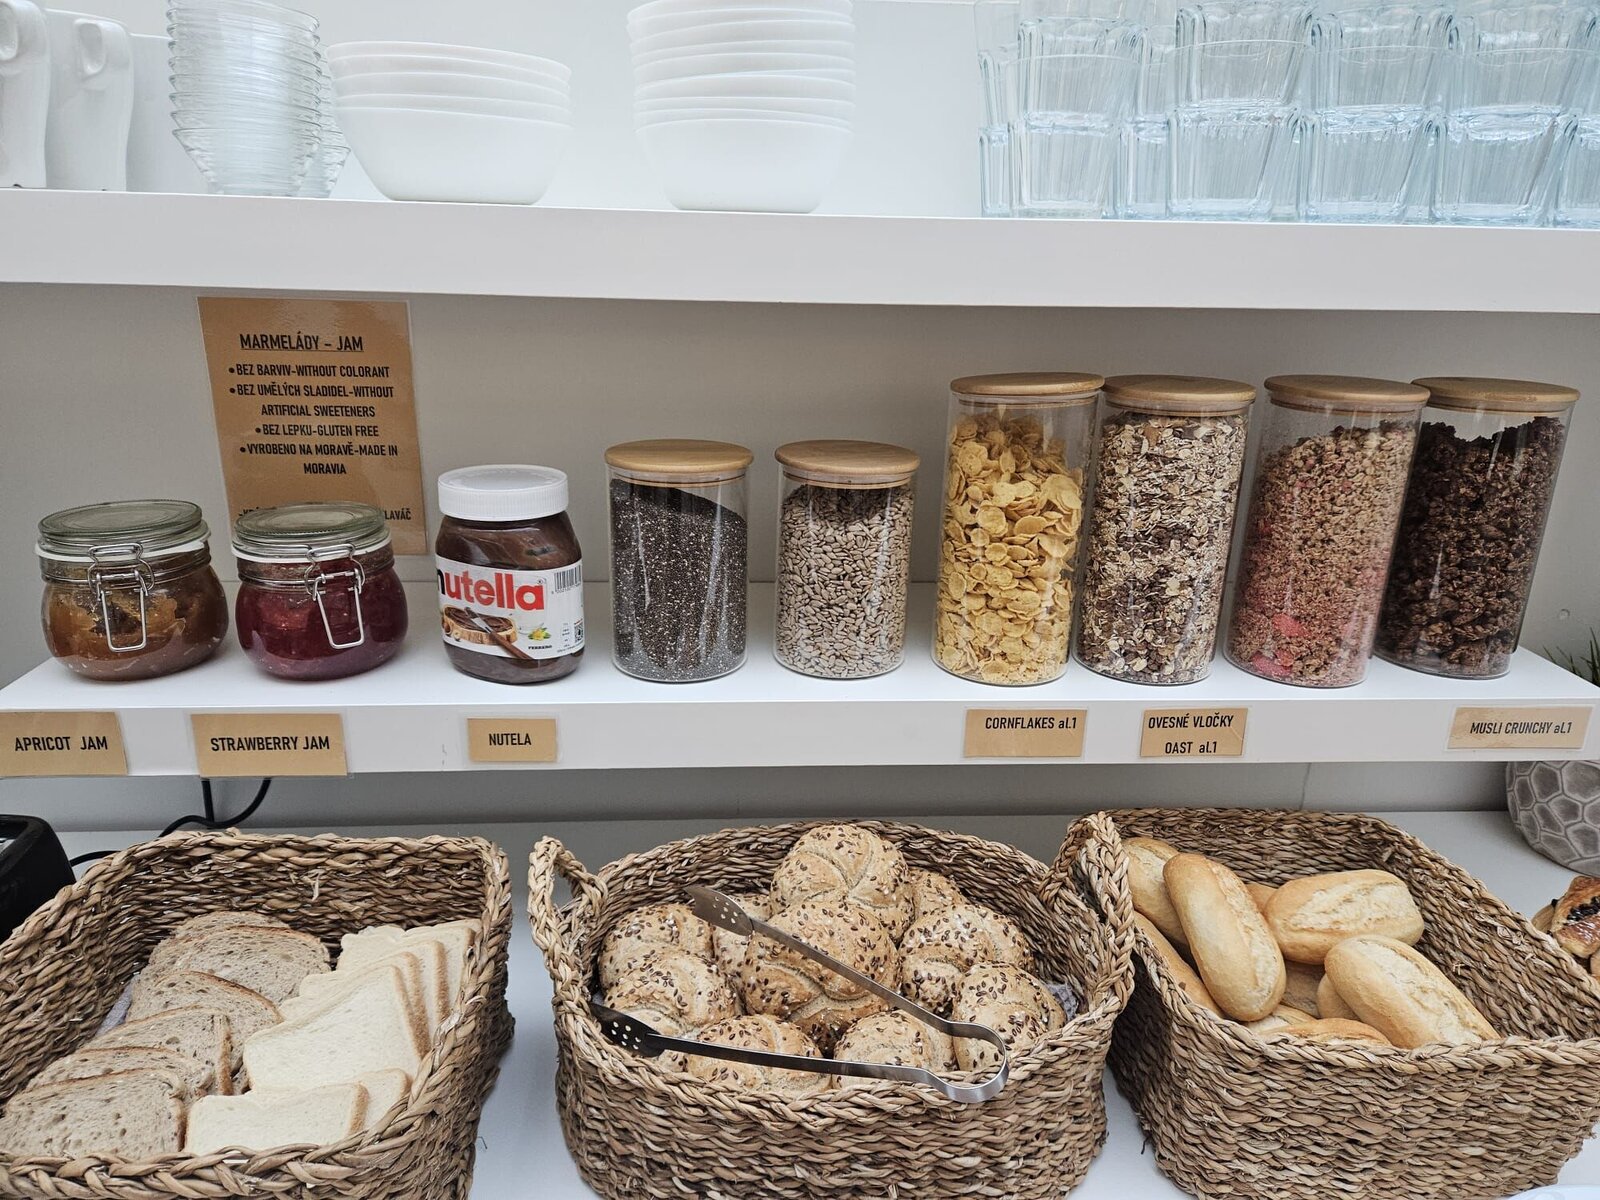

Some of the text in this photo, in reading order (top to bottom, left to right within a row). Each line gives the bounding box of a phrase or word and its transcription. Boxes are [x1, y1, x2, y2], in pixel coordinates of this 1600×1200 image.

[239, 331, 319, 350] MARMELÁDY
[336, 336, 363, 351] JAM
[236, 364, 390, 378] BEZ BARVIV-WITHOUT COLORANT
[237, 382, 394, 398] BEZ UMĚLÝCH SLADIDEL-WITHOUT
[261, 404, 376, 418] ARTIFICIAL SWEETENERS
[262, 424, 379, 437] BEZ LEPKU-GLUTEN FREE
[247, 441, 399, 456] VYROBENO NA MORAVĚ-MADE IN
[303, 463, 347, 475] MORAVIA
[383, 507, 412, 521] LAVÁČ
[436, 569, 544, 611] nutella
[985, 717, 1055, 730] CORNFLAKES
[1148, 712, 1234, 729] OVESNÉ VLOČKY
[1470, 722, 1503, 735] MUSLI
[1505, 721, 1553, 735] CRUNCHY
[14, 735, 109, 752] APRICOT JAM
[210, 736, 331, 752] STRAWBERRY JAM
[488, 732, 532, 746] NUTELA
[1165, 741, 1194, 755] OAST
